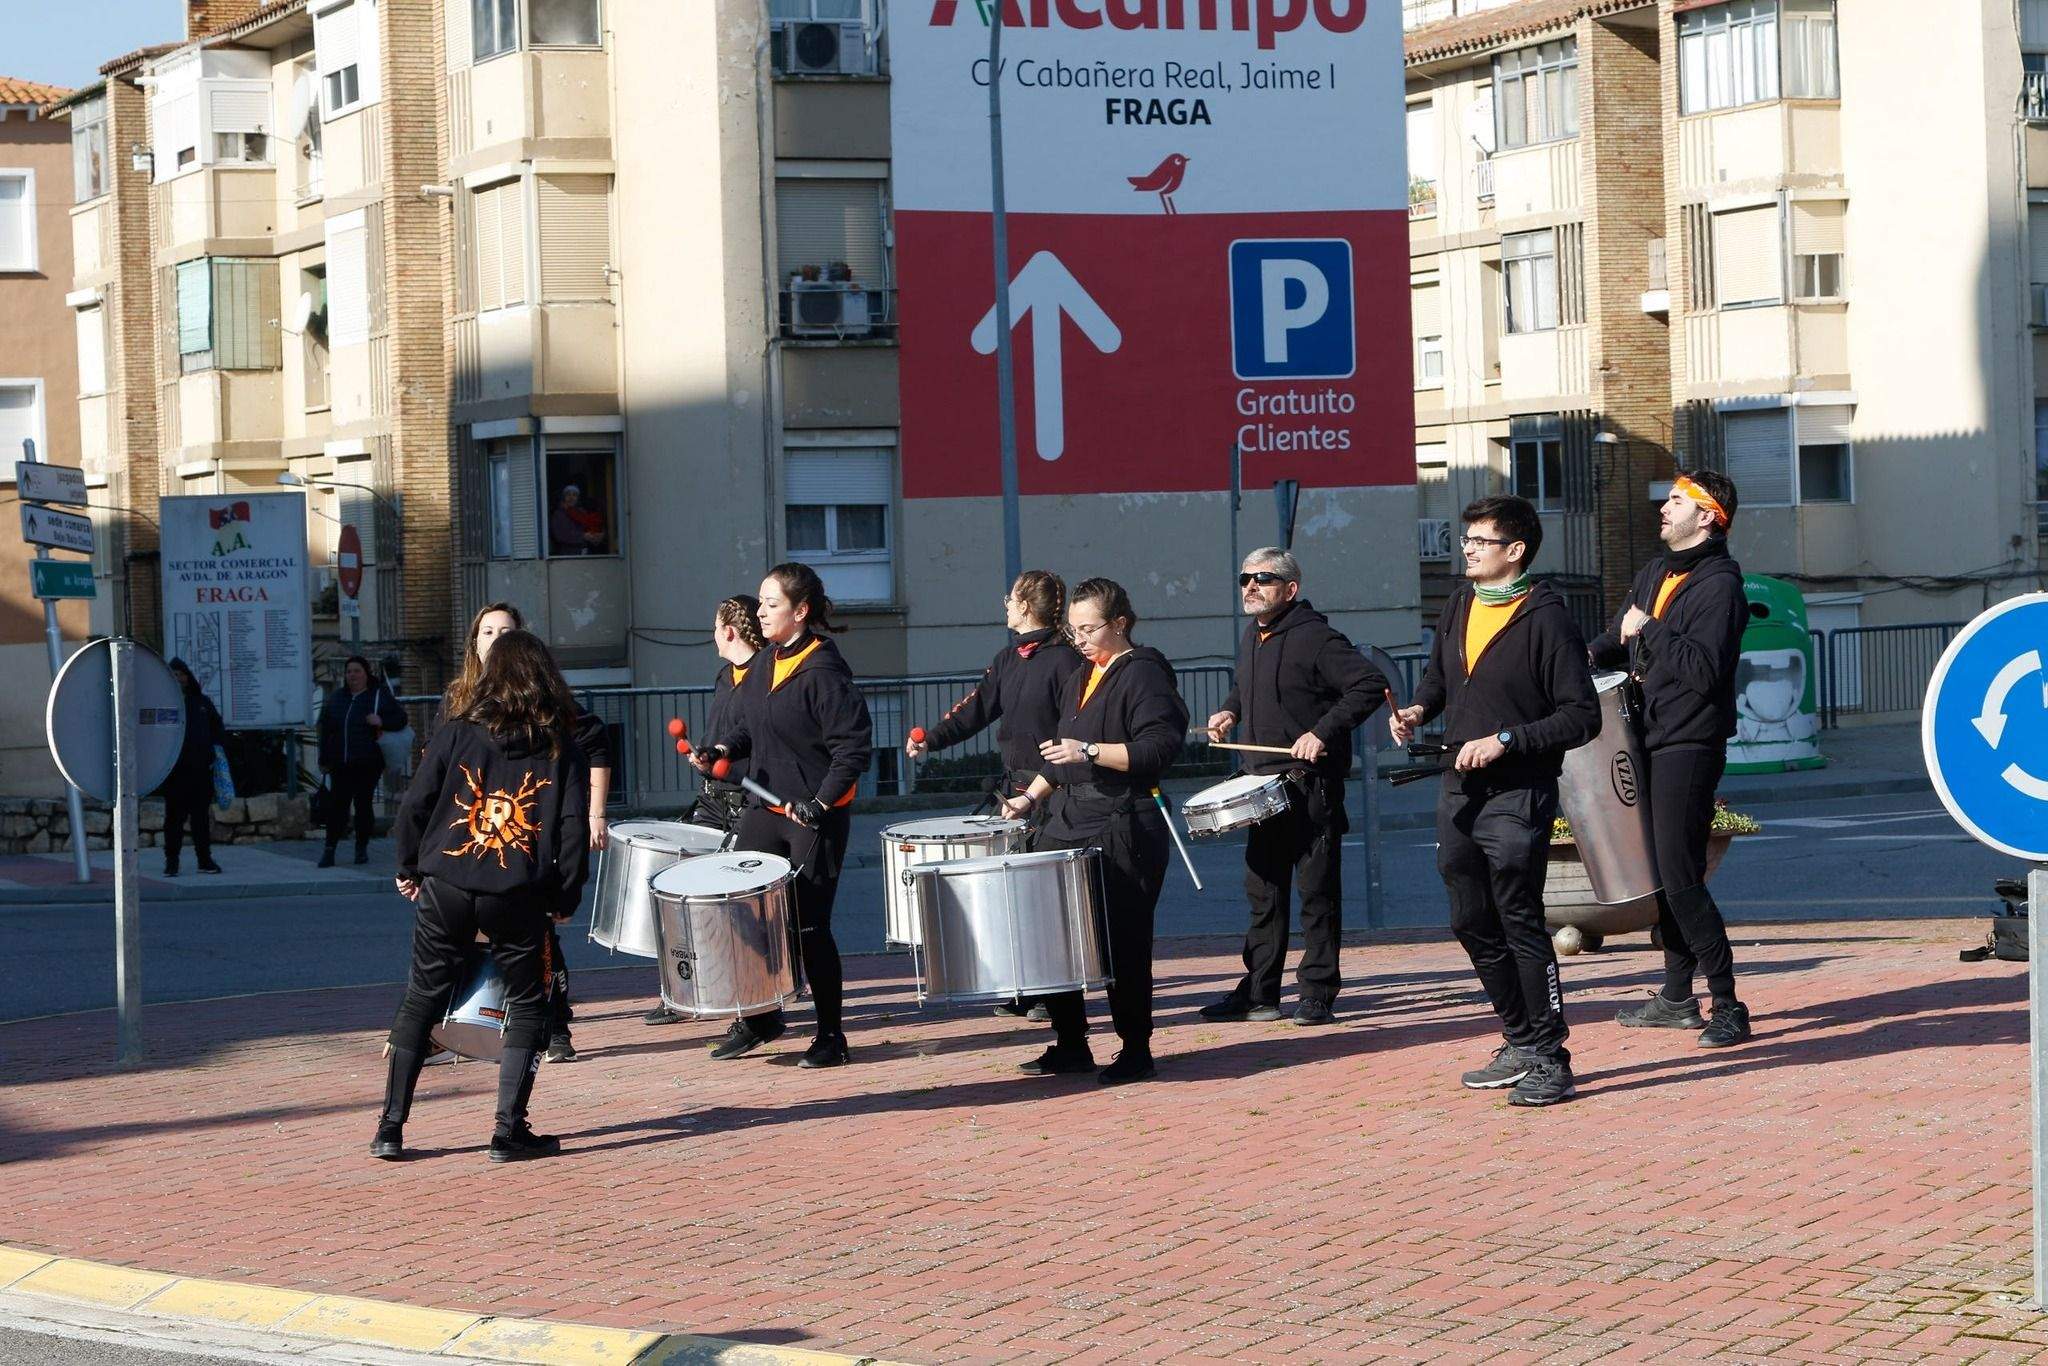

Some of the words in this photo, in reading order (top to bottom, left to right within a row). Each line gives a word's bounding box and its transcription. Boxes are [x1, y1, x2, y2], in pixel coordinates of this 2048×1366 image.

[971, 57, 1006, 87] C/
[1016, 59, 1155, 88] Cabañera
[1164, 61, 1232, 93] Real,
[1240, 62, 1321, 90] Jaime
[1105, 98, 1212, 125] FRAGA
[1261, 258, 1330, 363] P
[1236, 388, 1355, 416] Gratuito
[1237, 423, 1351, 452] Clientes
[168, 560, 217, 572] SECTOR
[220, 557, 297, 570] COMERCIAL
[179, 571, 212, 582] AVDA.
[216, 570, 231, 581] DE
[235, 569, 289, 581] ARAGON
[195, 586, 269, 604] FRAGA
[1614, 753, 1637, 801] IZZO
